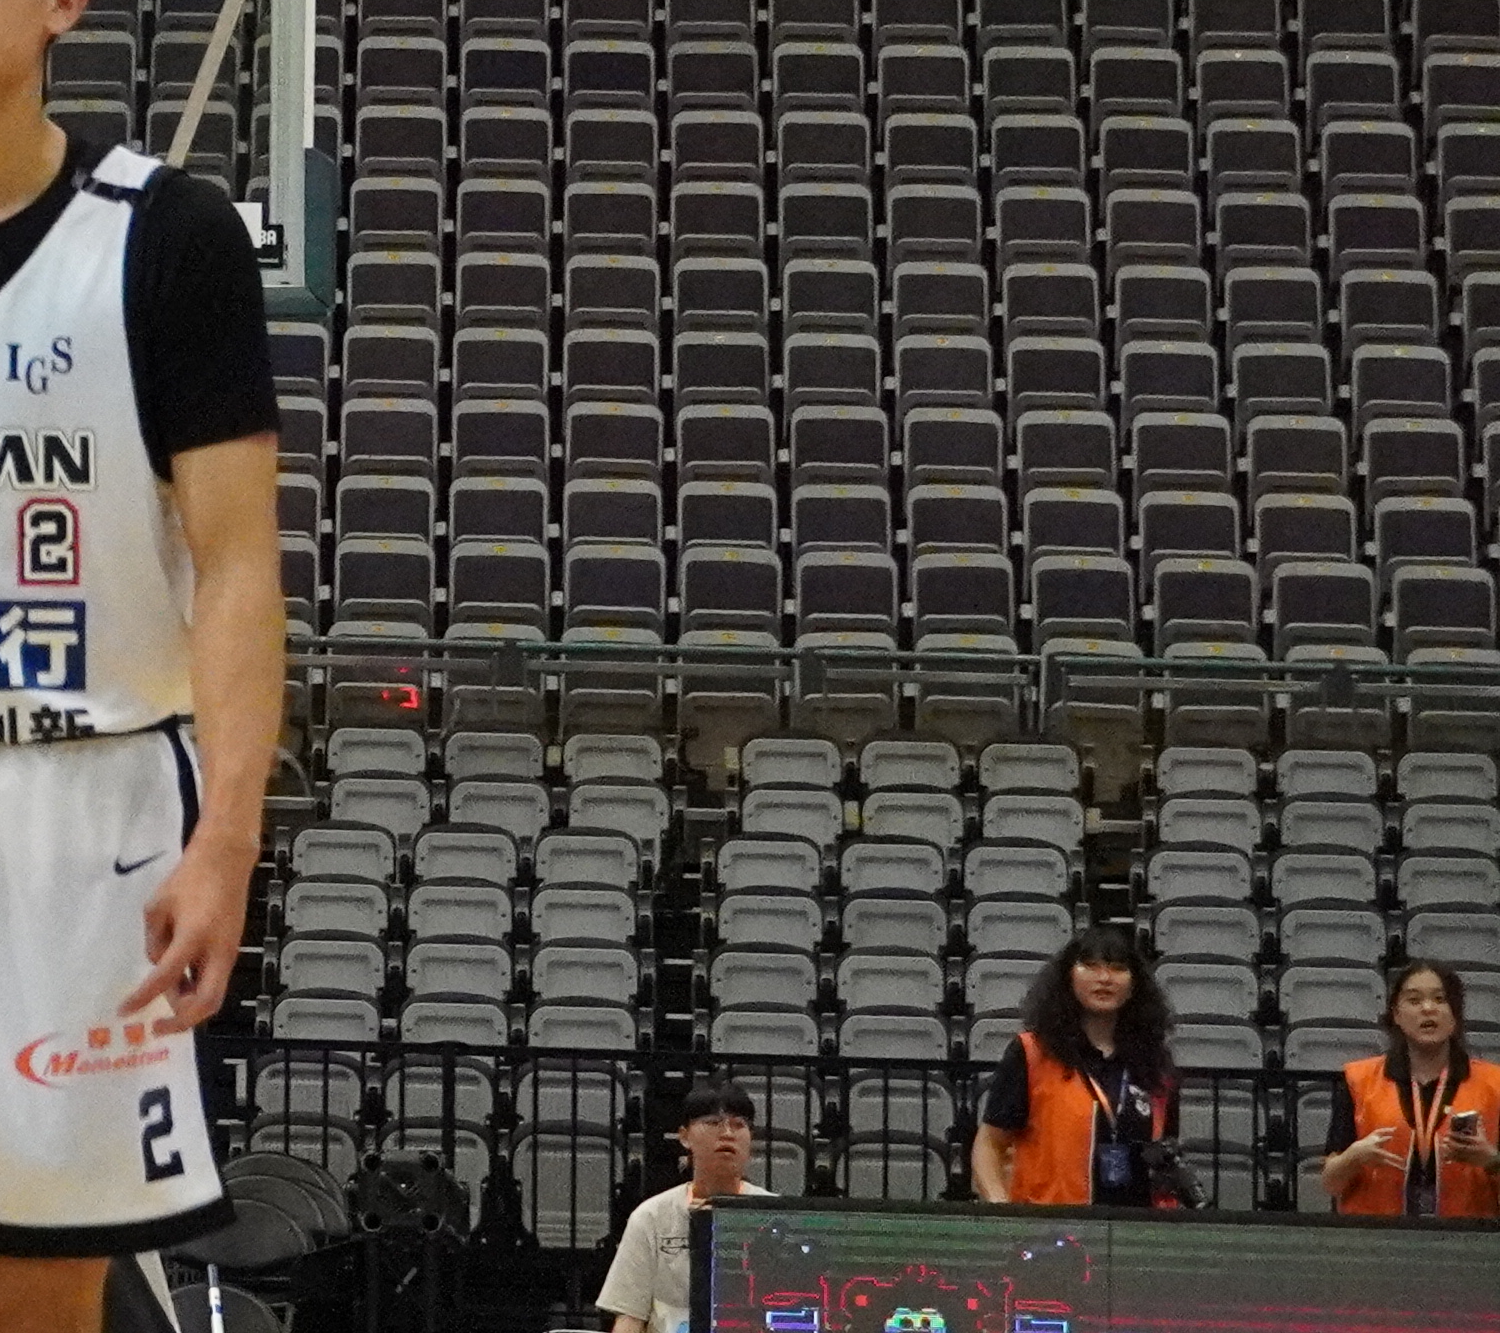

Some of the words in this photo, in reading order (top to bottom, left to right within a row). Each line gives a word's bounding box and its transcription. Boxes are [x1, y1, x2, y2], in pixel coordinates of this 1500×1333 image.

[5, 336, 74, 394] IGS
[24, 504, 73, 579] 2
[138, 1085, 185, 1183] 2
